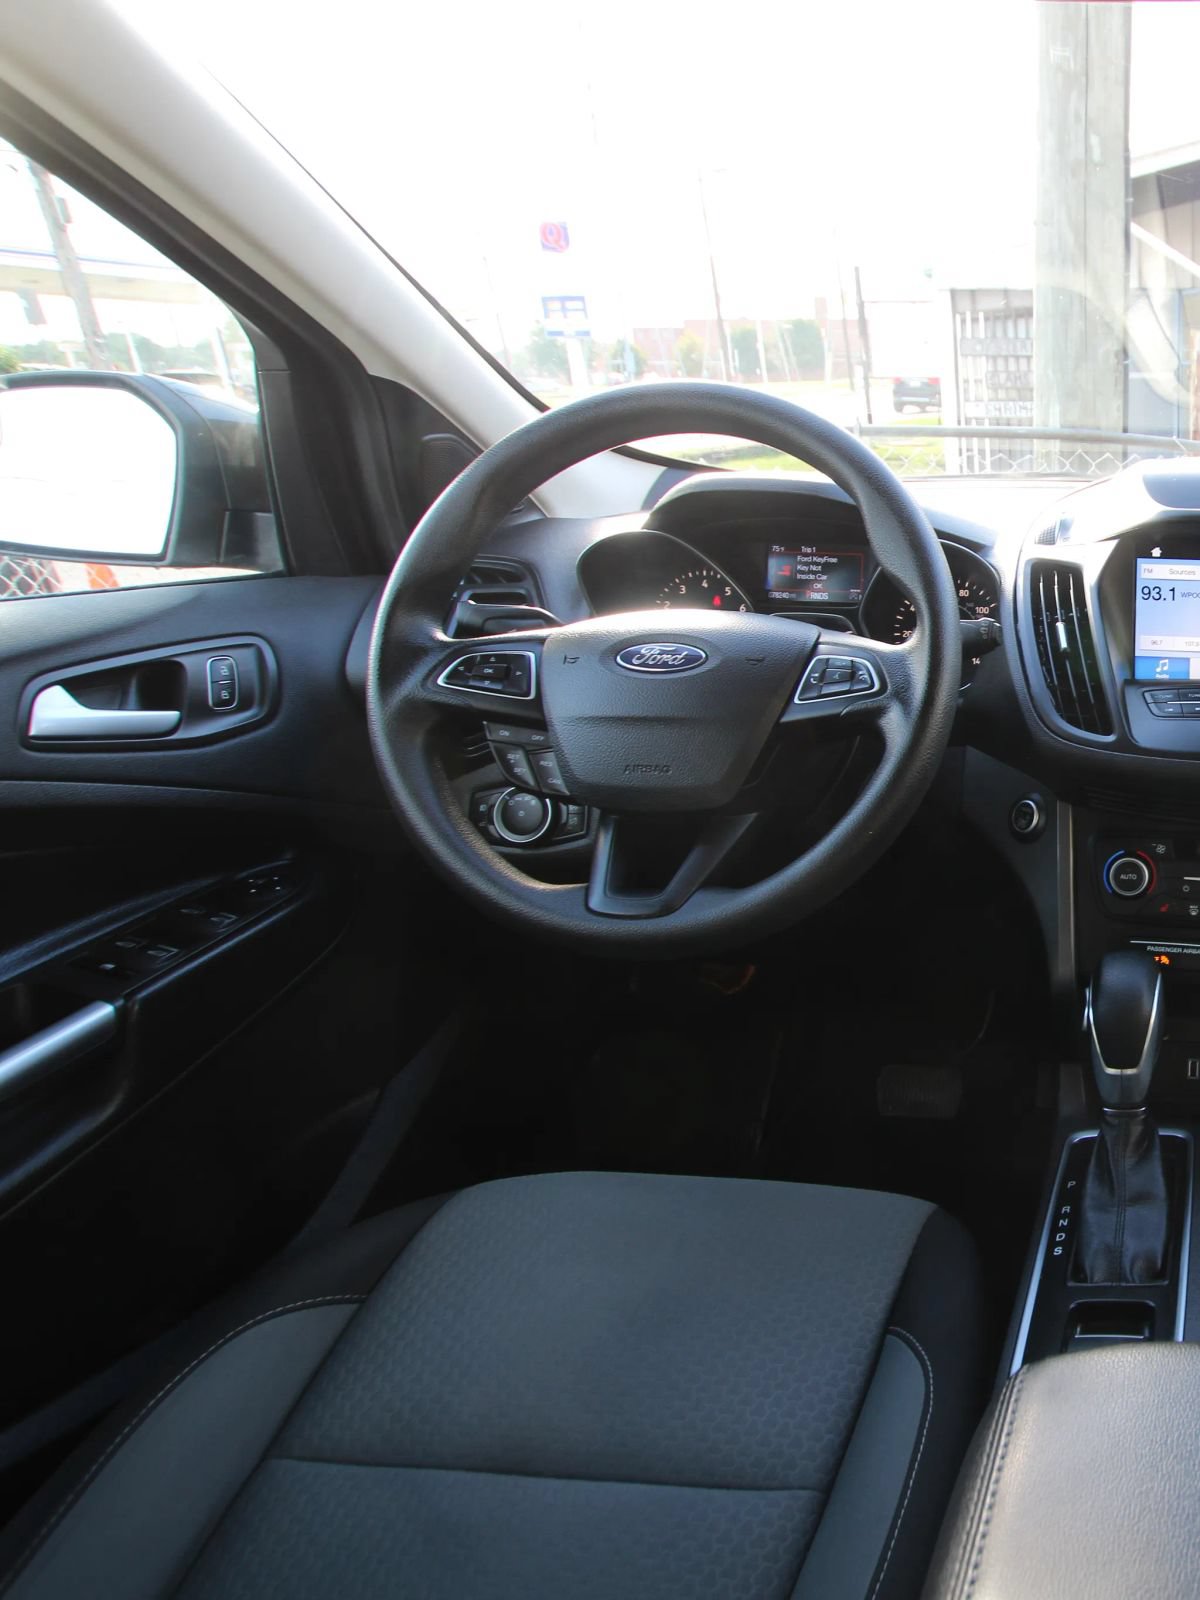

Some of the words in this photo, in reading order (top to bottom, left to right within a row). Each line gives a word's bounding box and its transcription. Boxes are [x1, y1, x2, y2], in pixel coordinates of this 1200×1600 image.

[1168, 568, 1197, 576] Sources
[701, 579, 709, 588] 4
[679, 585, 687, 595] 3
[724, 587, 732, 596] 5
[1141, 585, 1176, 601] 93.1
[739, 604, 747, 613] 6
[631, 645, 689, 665] Ford
[971, 657, 981, 665] 14
[623, 764, 673, 775] AIRBAG
[1146, 945, 1182, 953] PASSENGER
[1067, 1180, 1077, 1189] P
[1061, 1205, 1071, 1214] R
[1058, 1218, 1069, 1227] N
[1055, 1232, 1066, 1242] D
[1053, 1246, 1063, 1256] S
